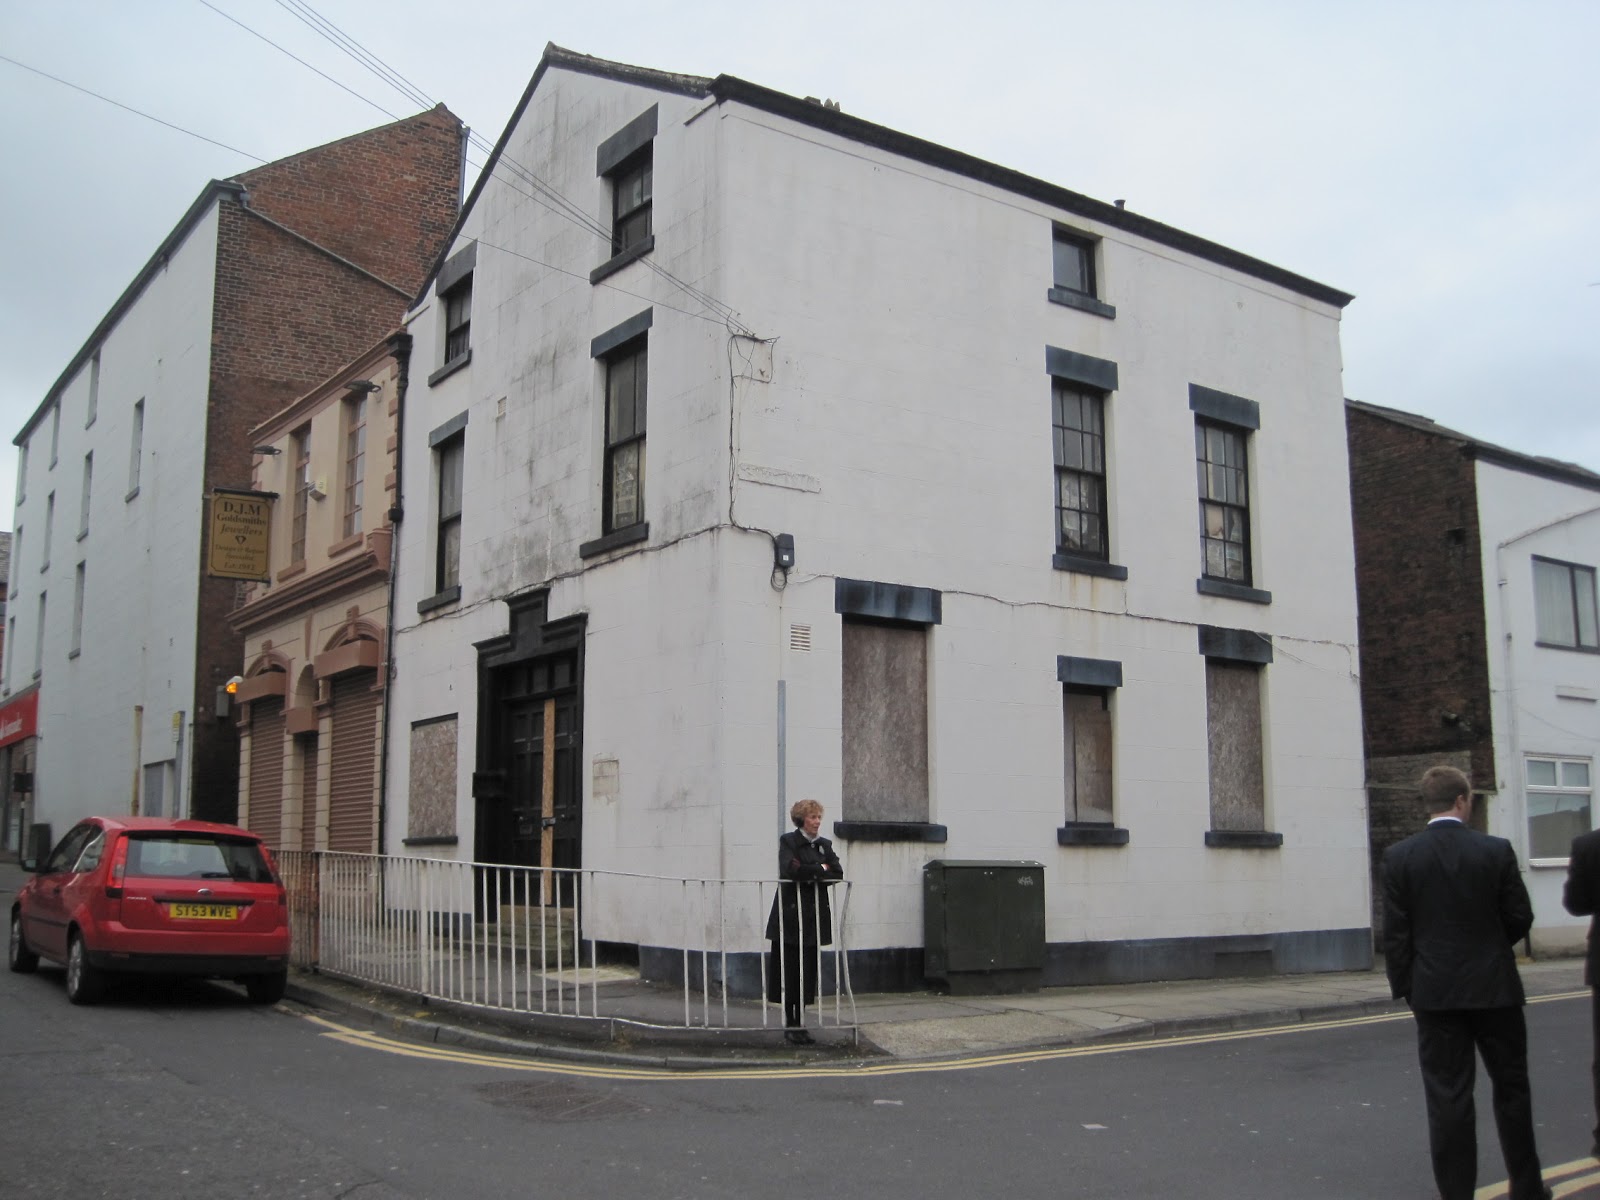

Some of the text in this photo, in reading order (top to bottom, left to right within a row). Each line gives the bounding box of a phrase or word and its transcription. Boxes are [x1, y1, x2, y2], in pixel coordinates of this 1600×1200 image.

[224, 501, 260, 515] D.J.M
[217, 513, 266, 525] Goldsmiths
[220, 524, 263, 536] Jewellers
[175, 904, 232, 917] ST53 WVE
